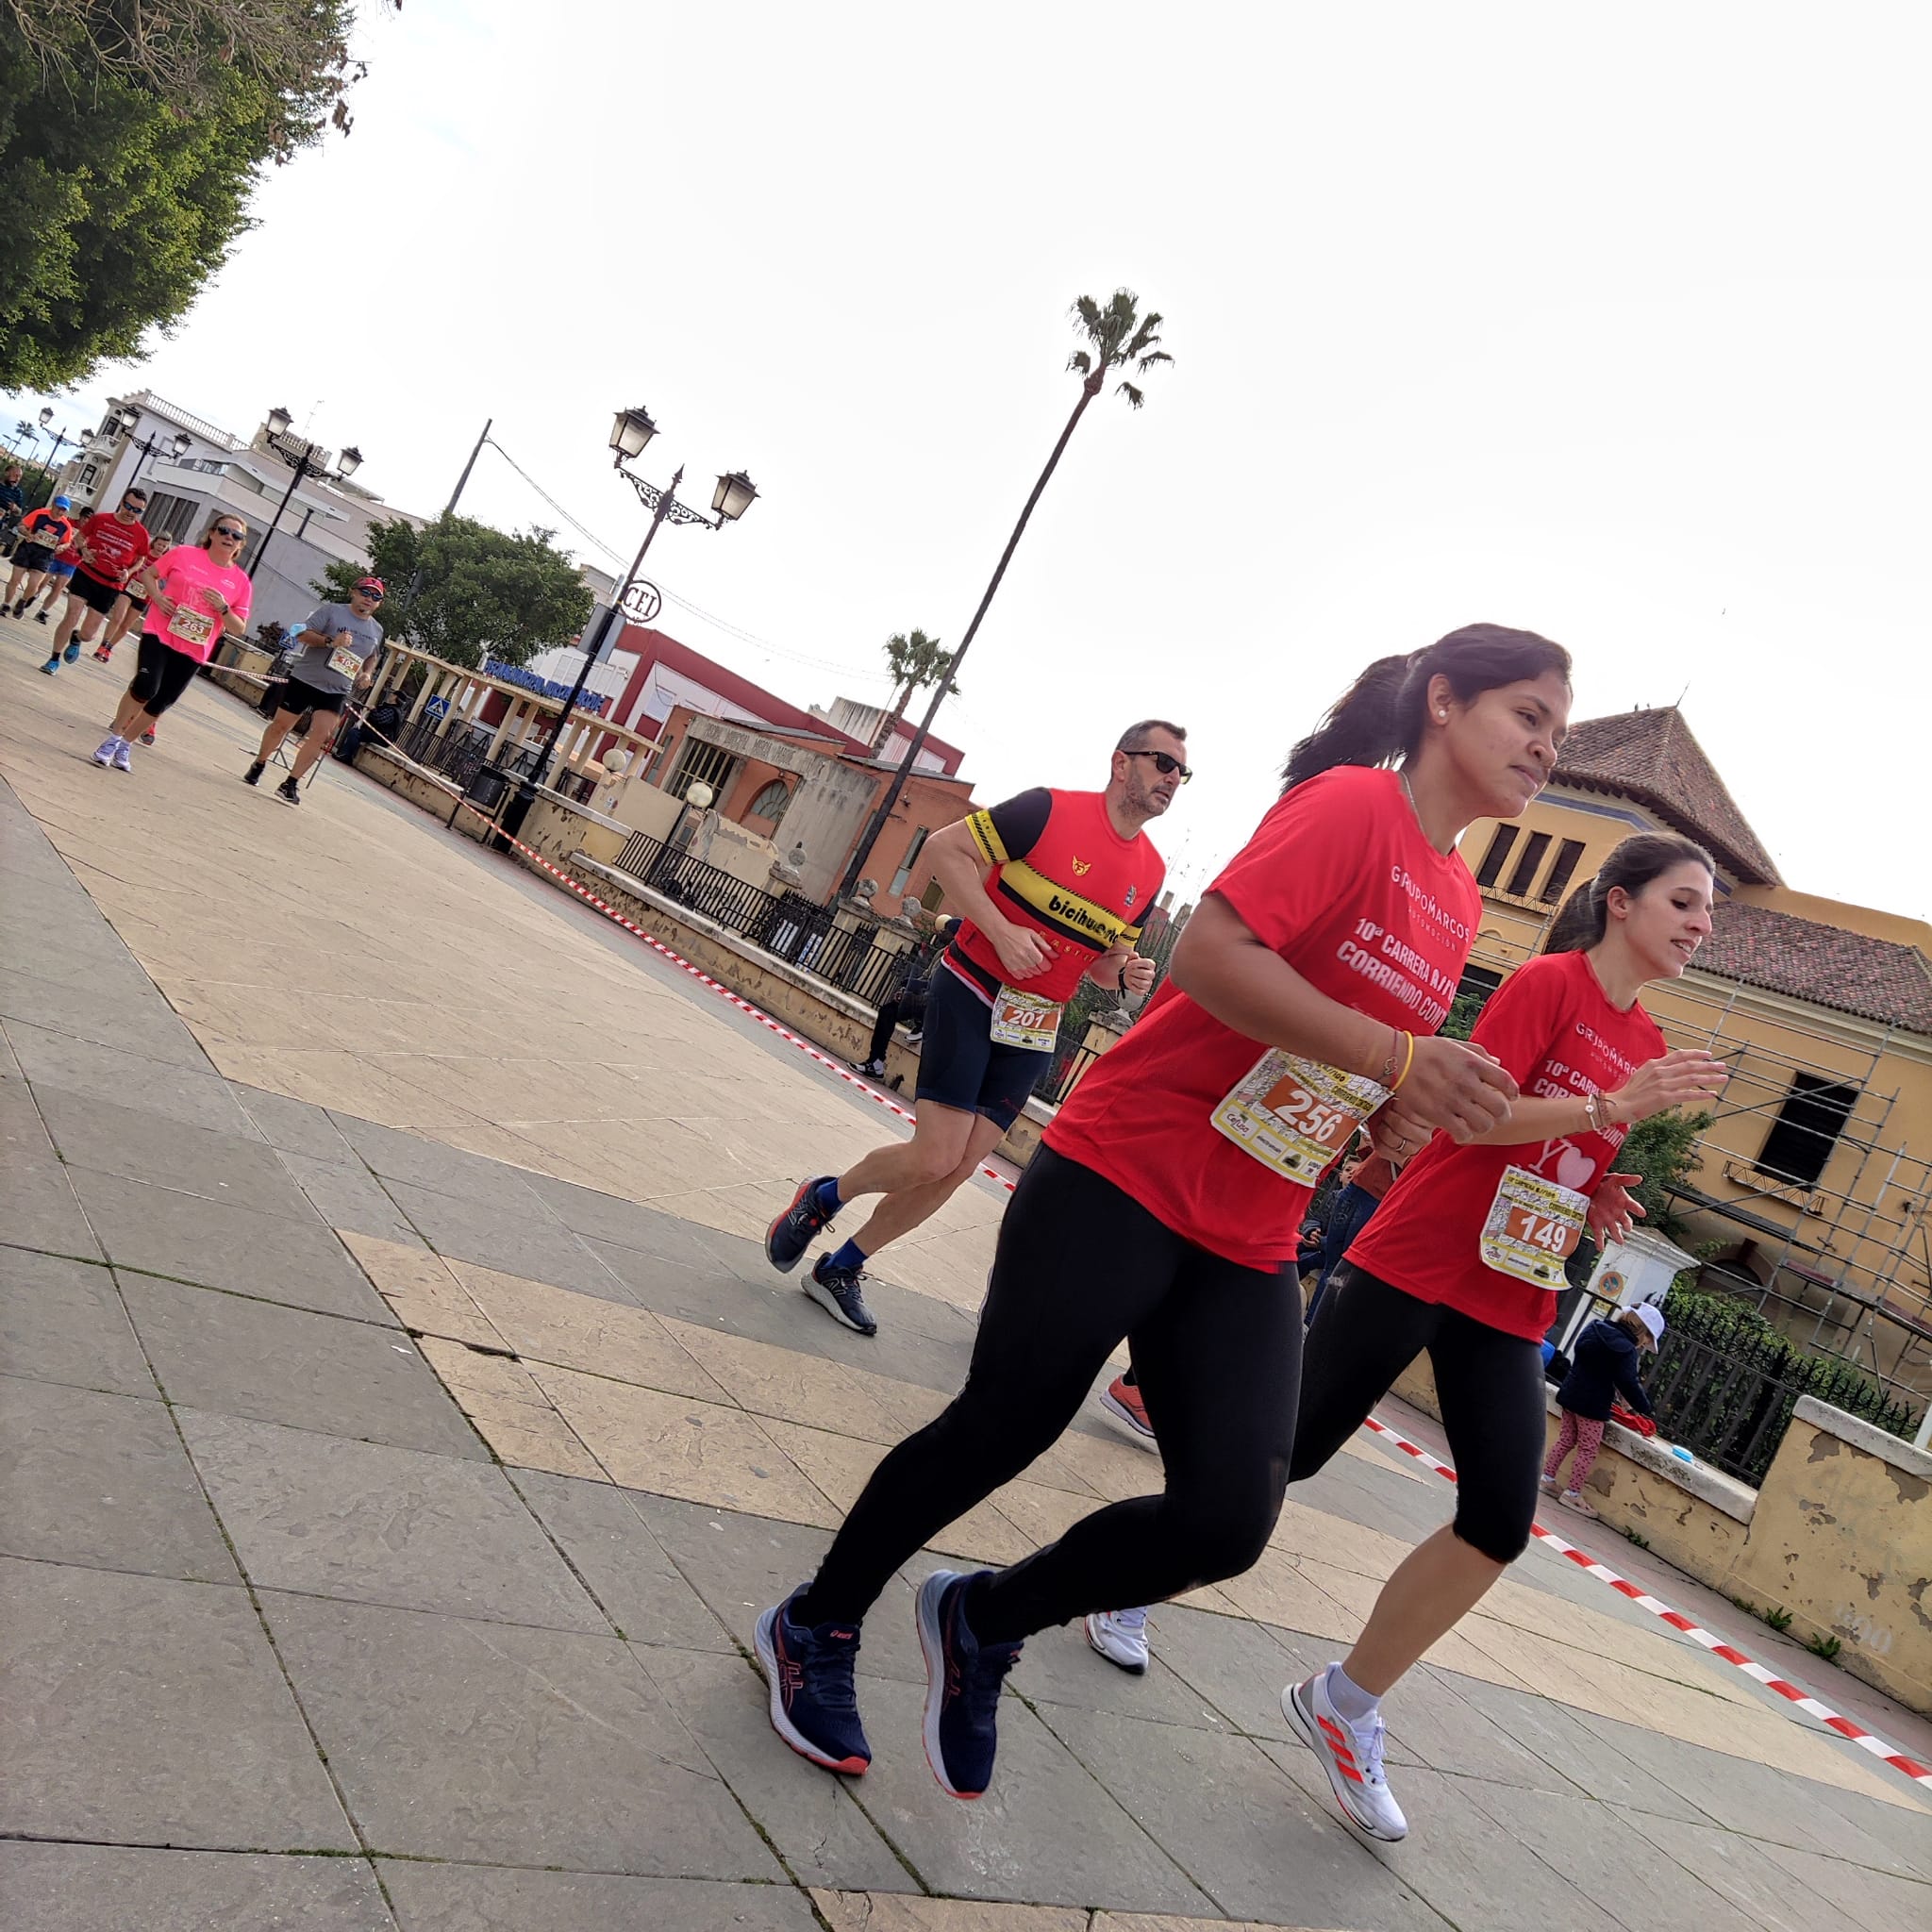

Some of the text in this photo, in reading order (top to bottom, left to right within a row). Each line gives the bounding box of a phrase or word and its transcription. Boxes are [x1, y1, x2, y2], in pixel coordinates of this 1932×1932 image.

[624, 587, 657, 617] CEI
[181, 620, 205, 634] 263
[1337, 940, 1424, 1009] CORRIENDO
[1381, 934, 1430, 983] CARRERA
[1008, 1009, 1044, 1028] 201
[1274, 1090, 1343, 1142] 256
[1521, 1214, 1567, 1253] 149
